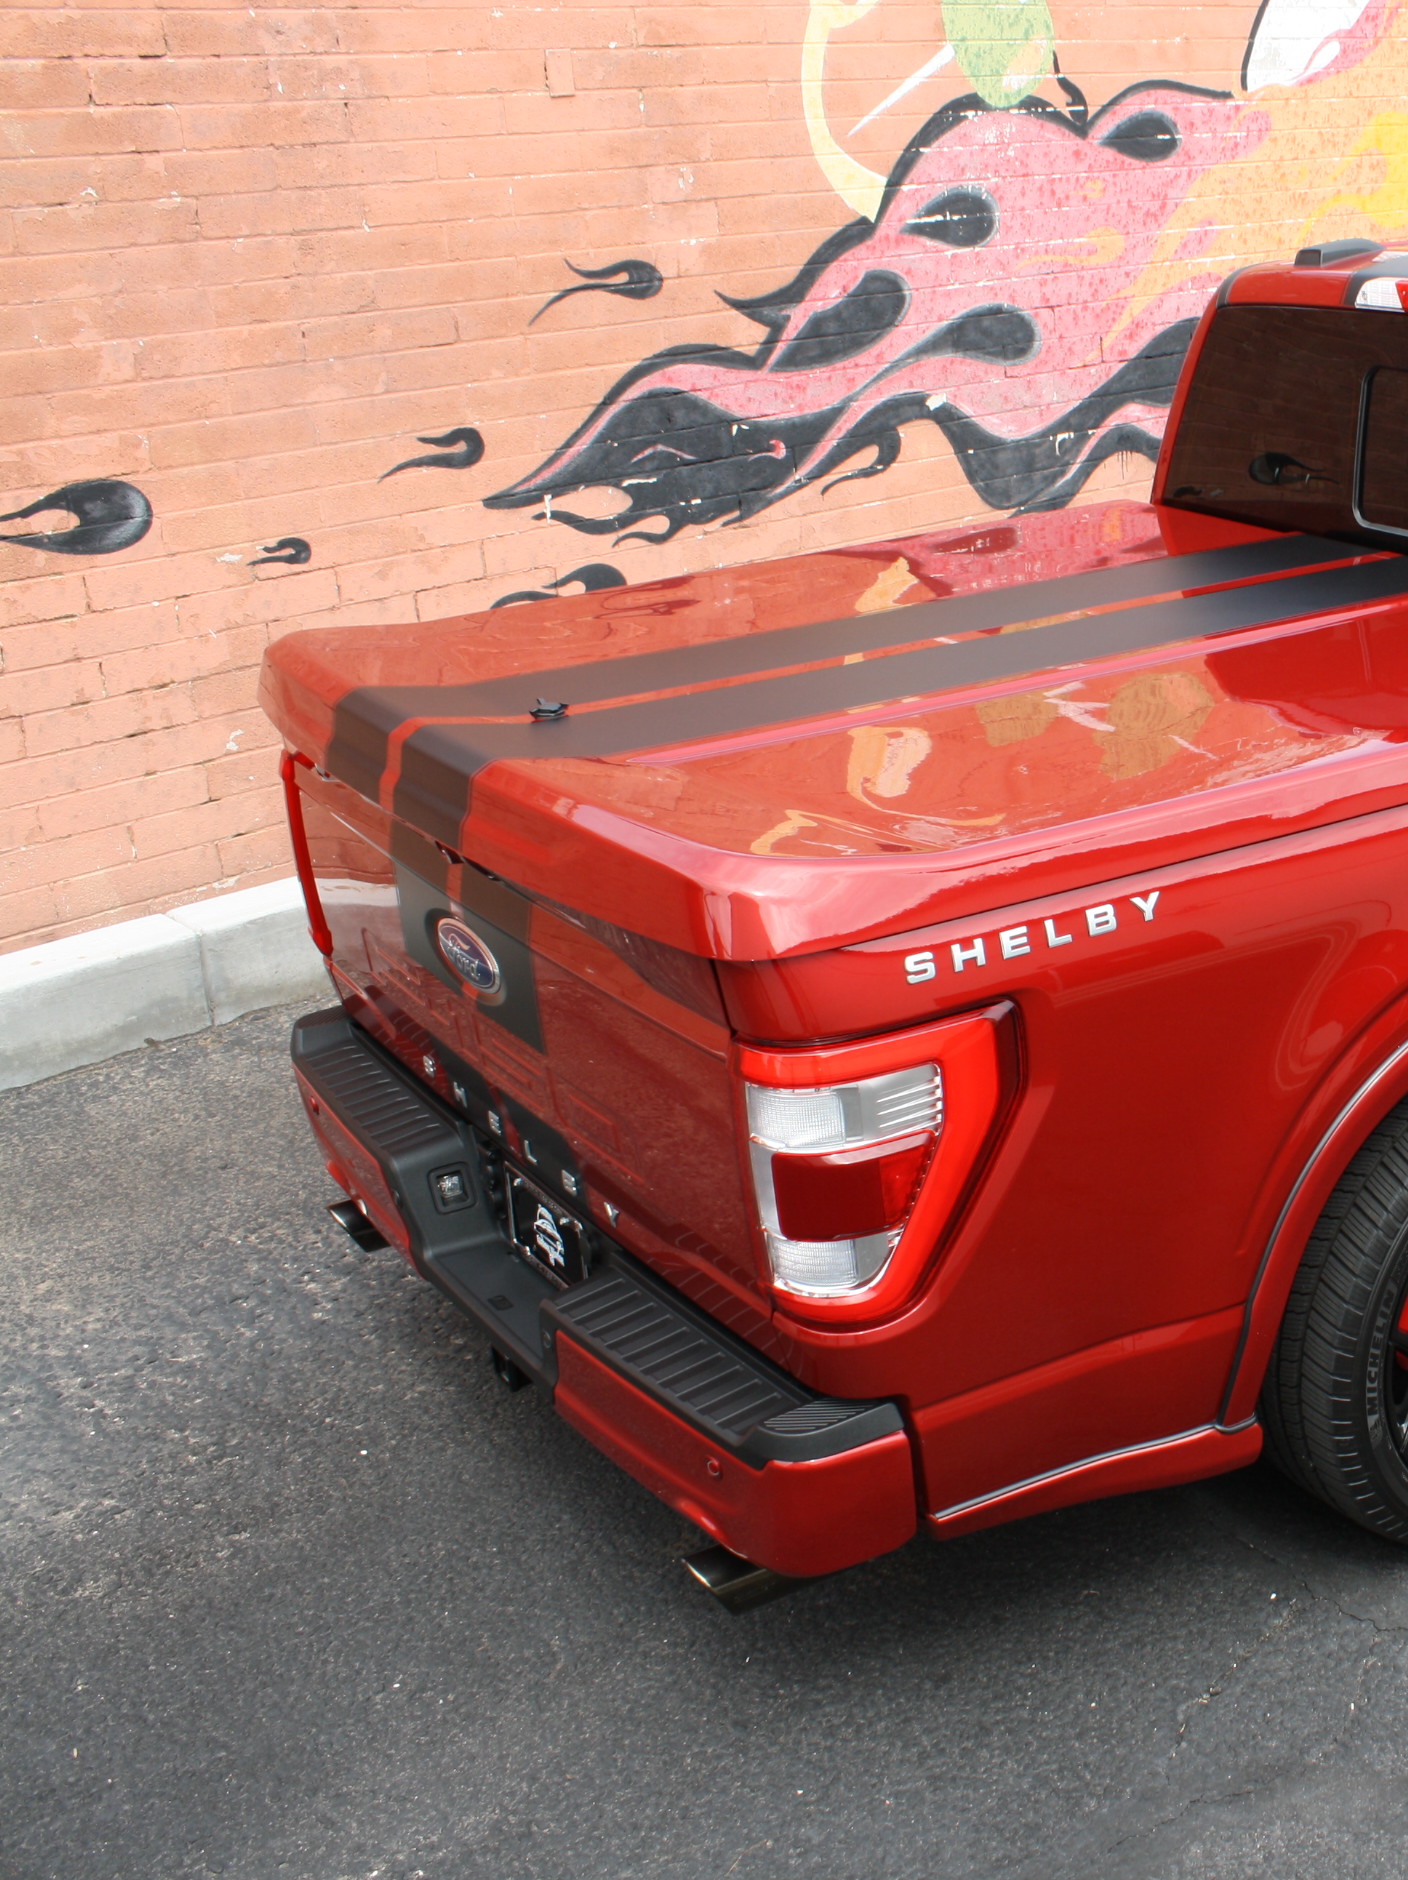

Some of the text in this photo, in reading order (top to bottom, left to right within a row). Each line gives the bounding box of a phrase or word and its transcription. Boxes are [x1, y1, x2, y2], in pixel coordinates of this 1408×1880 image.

[904, 890, 1160, 985] SHELBY
[422, 1055, 619, 1229] SHELBY
[1366, 1288, 1396, 1417] MICHELIN
